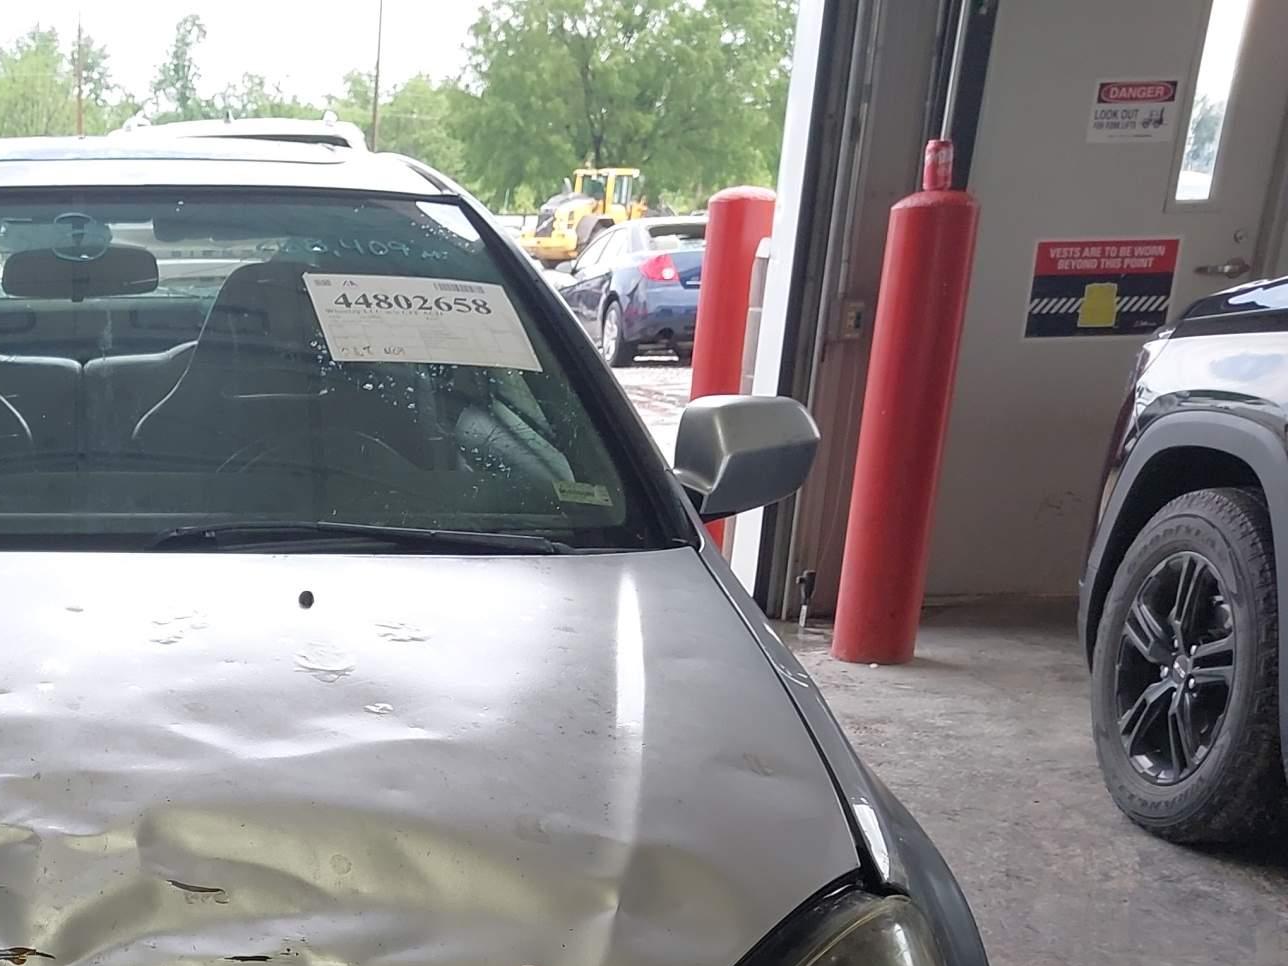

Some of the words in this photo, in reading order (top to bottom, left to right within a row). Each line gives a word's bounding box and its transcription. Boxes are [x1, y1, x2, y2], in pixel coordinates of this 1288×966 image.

[1109, 85, 1165, 99] DANGER
[1095, 109, 1119, 121] LOOK
[1120, 108, 1139, 120] OUT
[1049, 247, 1081, 258] VESTS
[1081, 246, 1102, 257] ARE
[1104, 246, 1118, 257] TO
[1119, 246, 1133, 257] BE
[1134, 245, 1166, 257] WORN
[1057, 258, 1098, 270] BEYOND
[1100, 258, 1122, 269] THIS
[1123, 257, 1155, 268] POINT
[334, 292, 493, 316] 44802658
